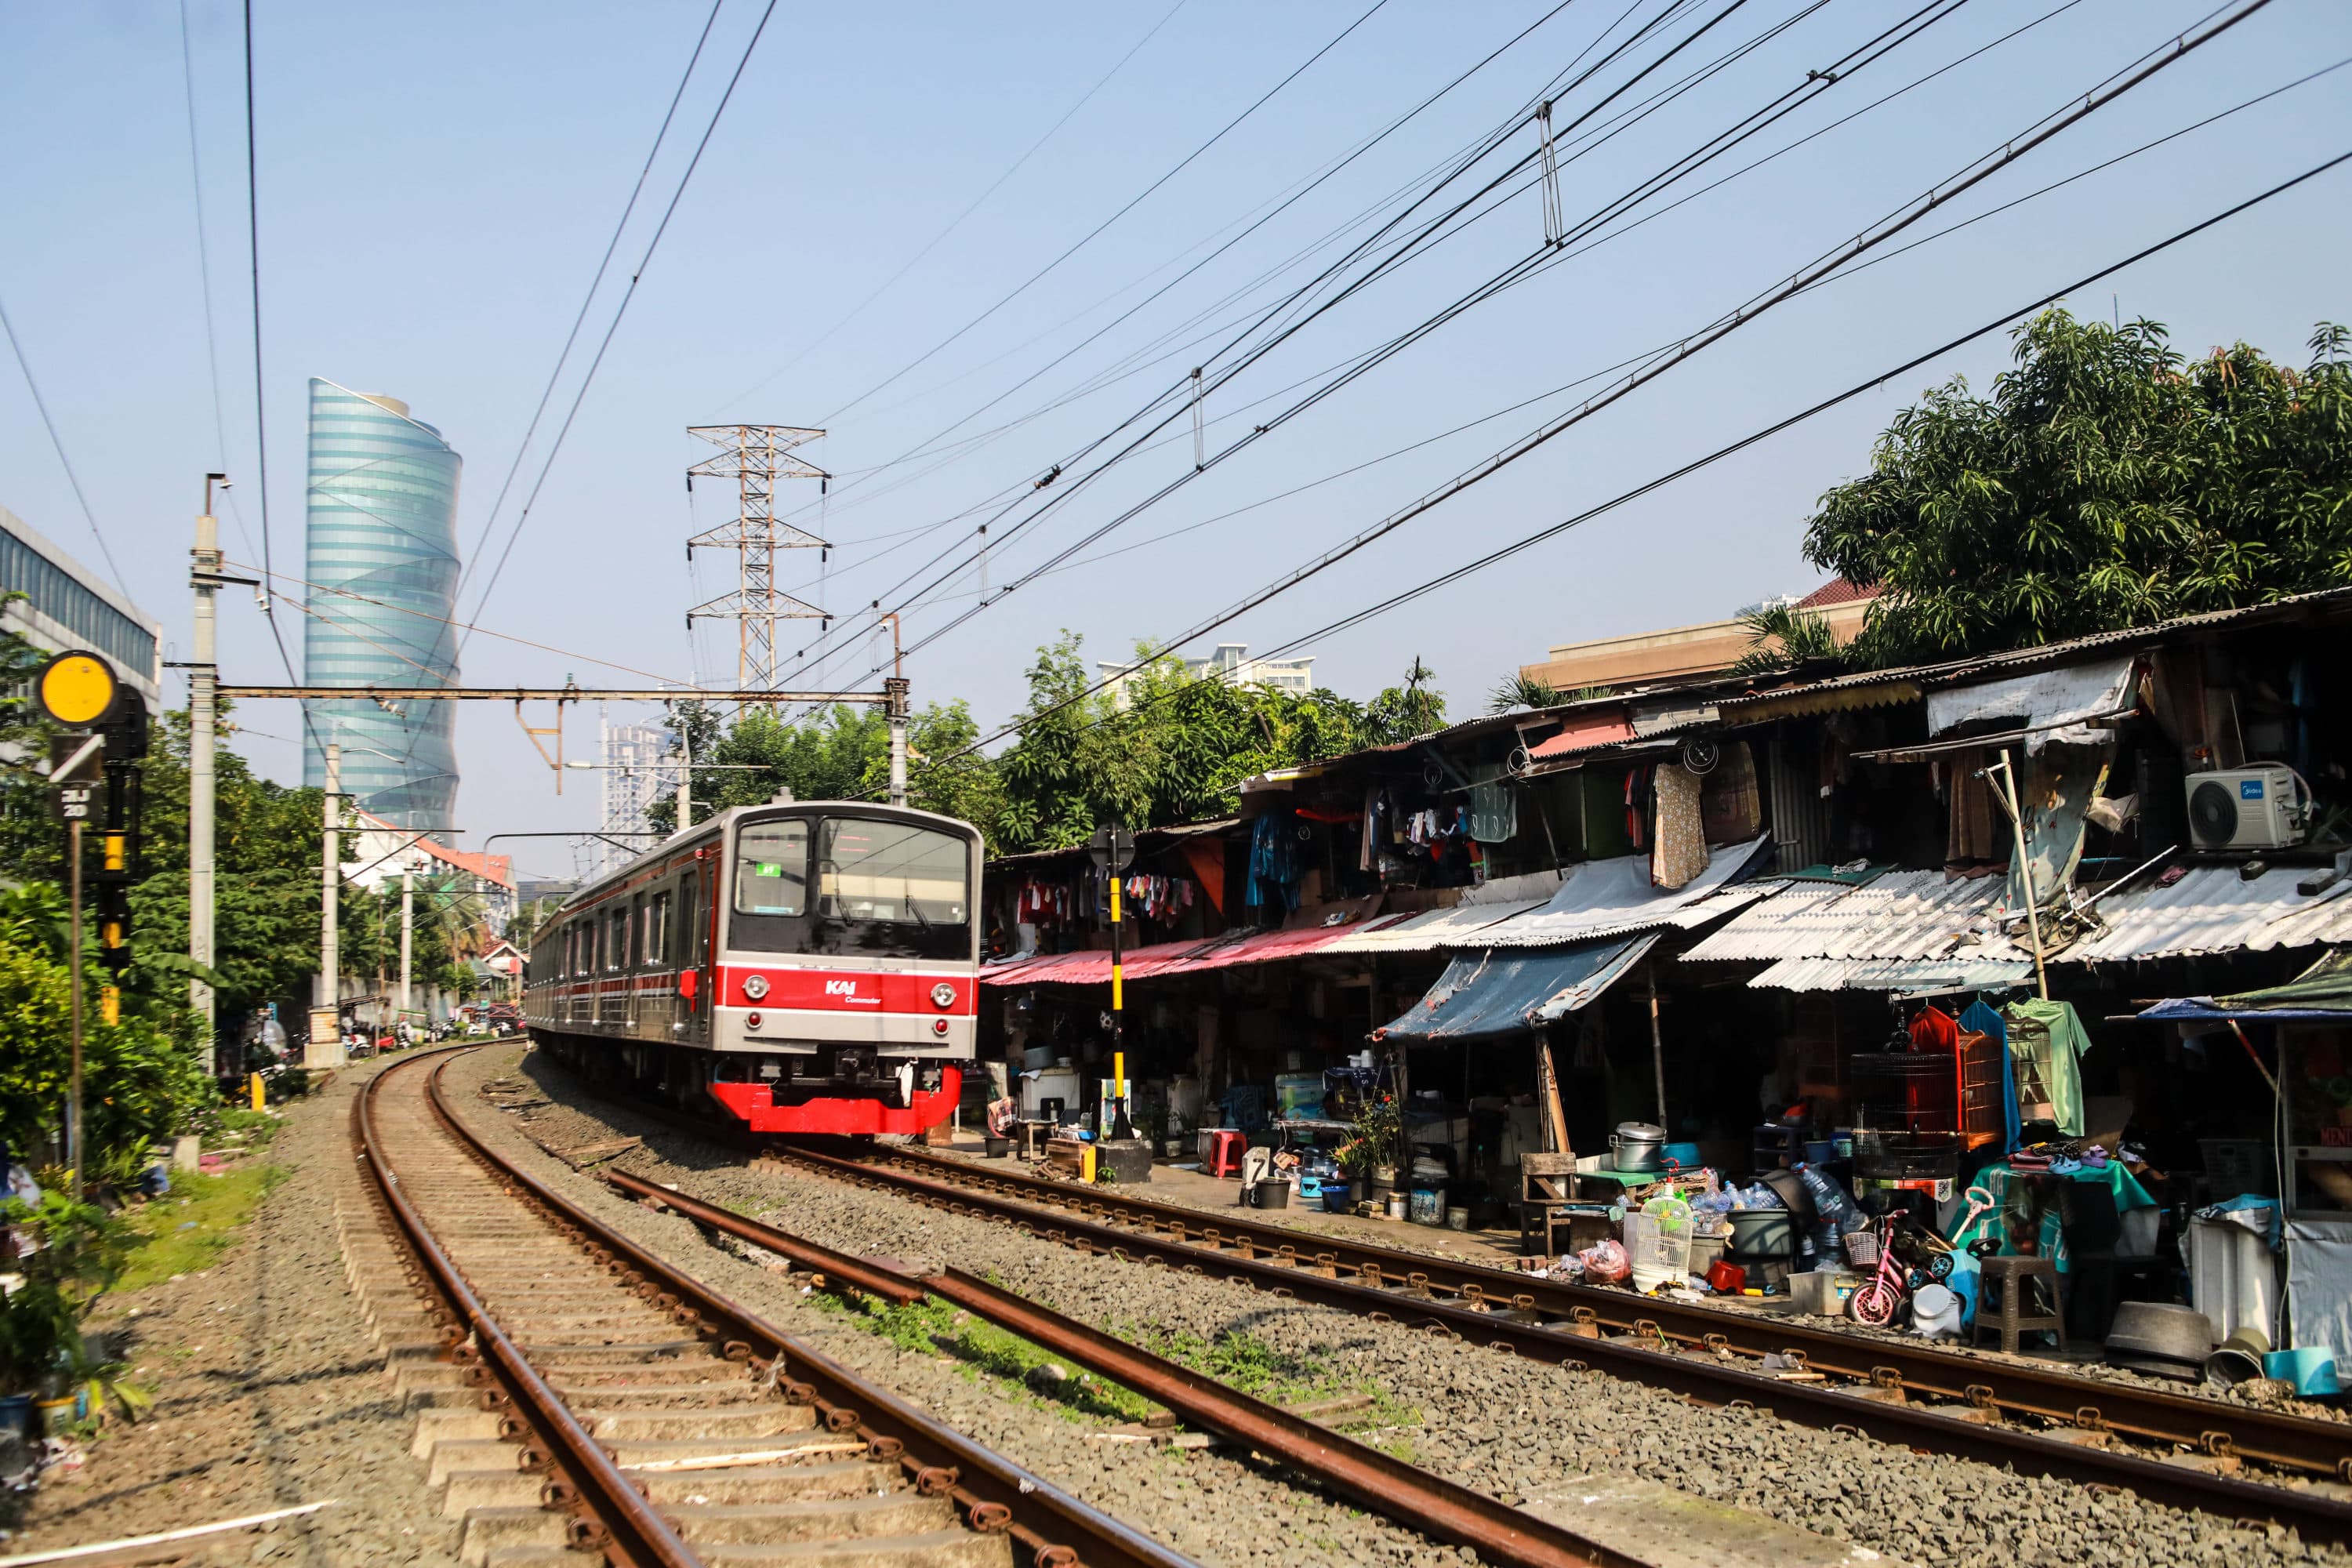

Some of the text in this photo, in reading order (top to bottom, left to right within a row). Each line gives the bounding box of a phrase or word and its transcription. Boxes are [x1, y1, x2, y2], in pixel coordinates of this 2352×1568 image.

[63, 804, 89, 817] 20
[825, 980, 856, 996] KAI
[845, 996, 882, 1004] Commuter
[1252, 1158, 1266, 1183] 7
